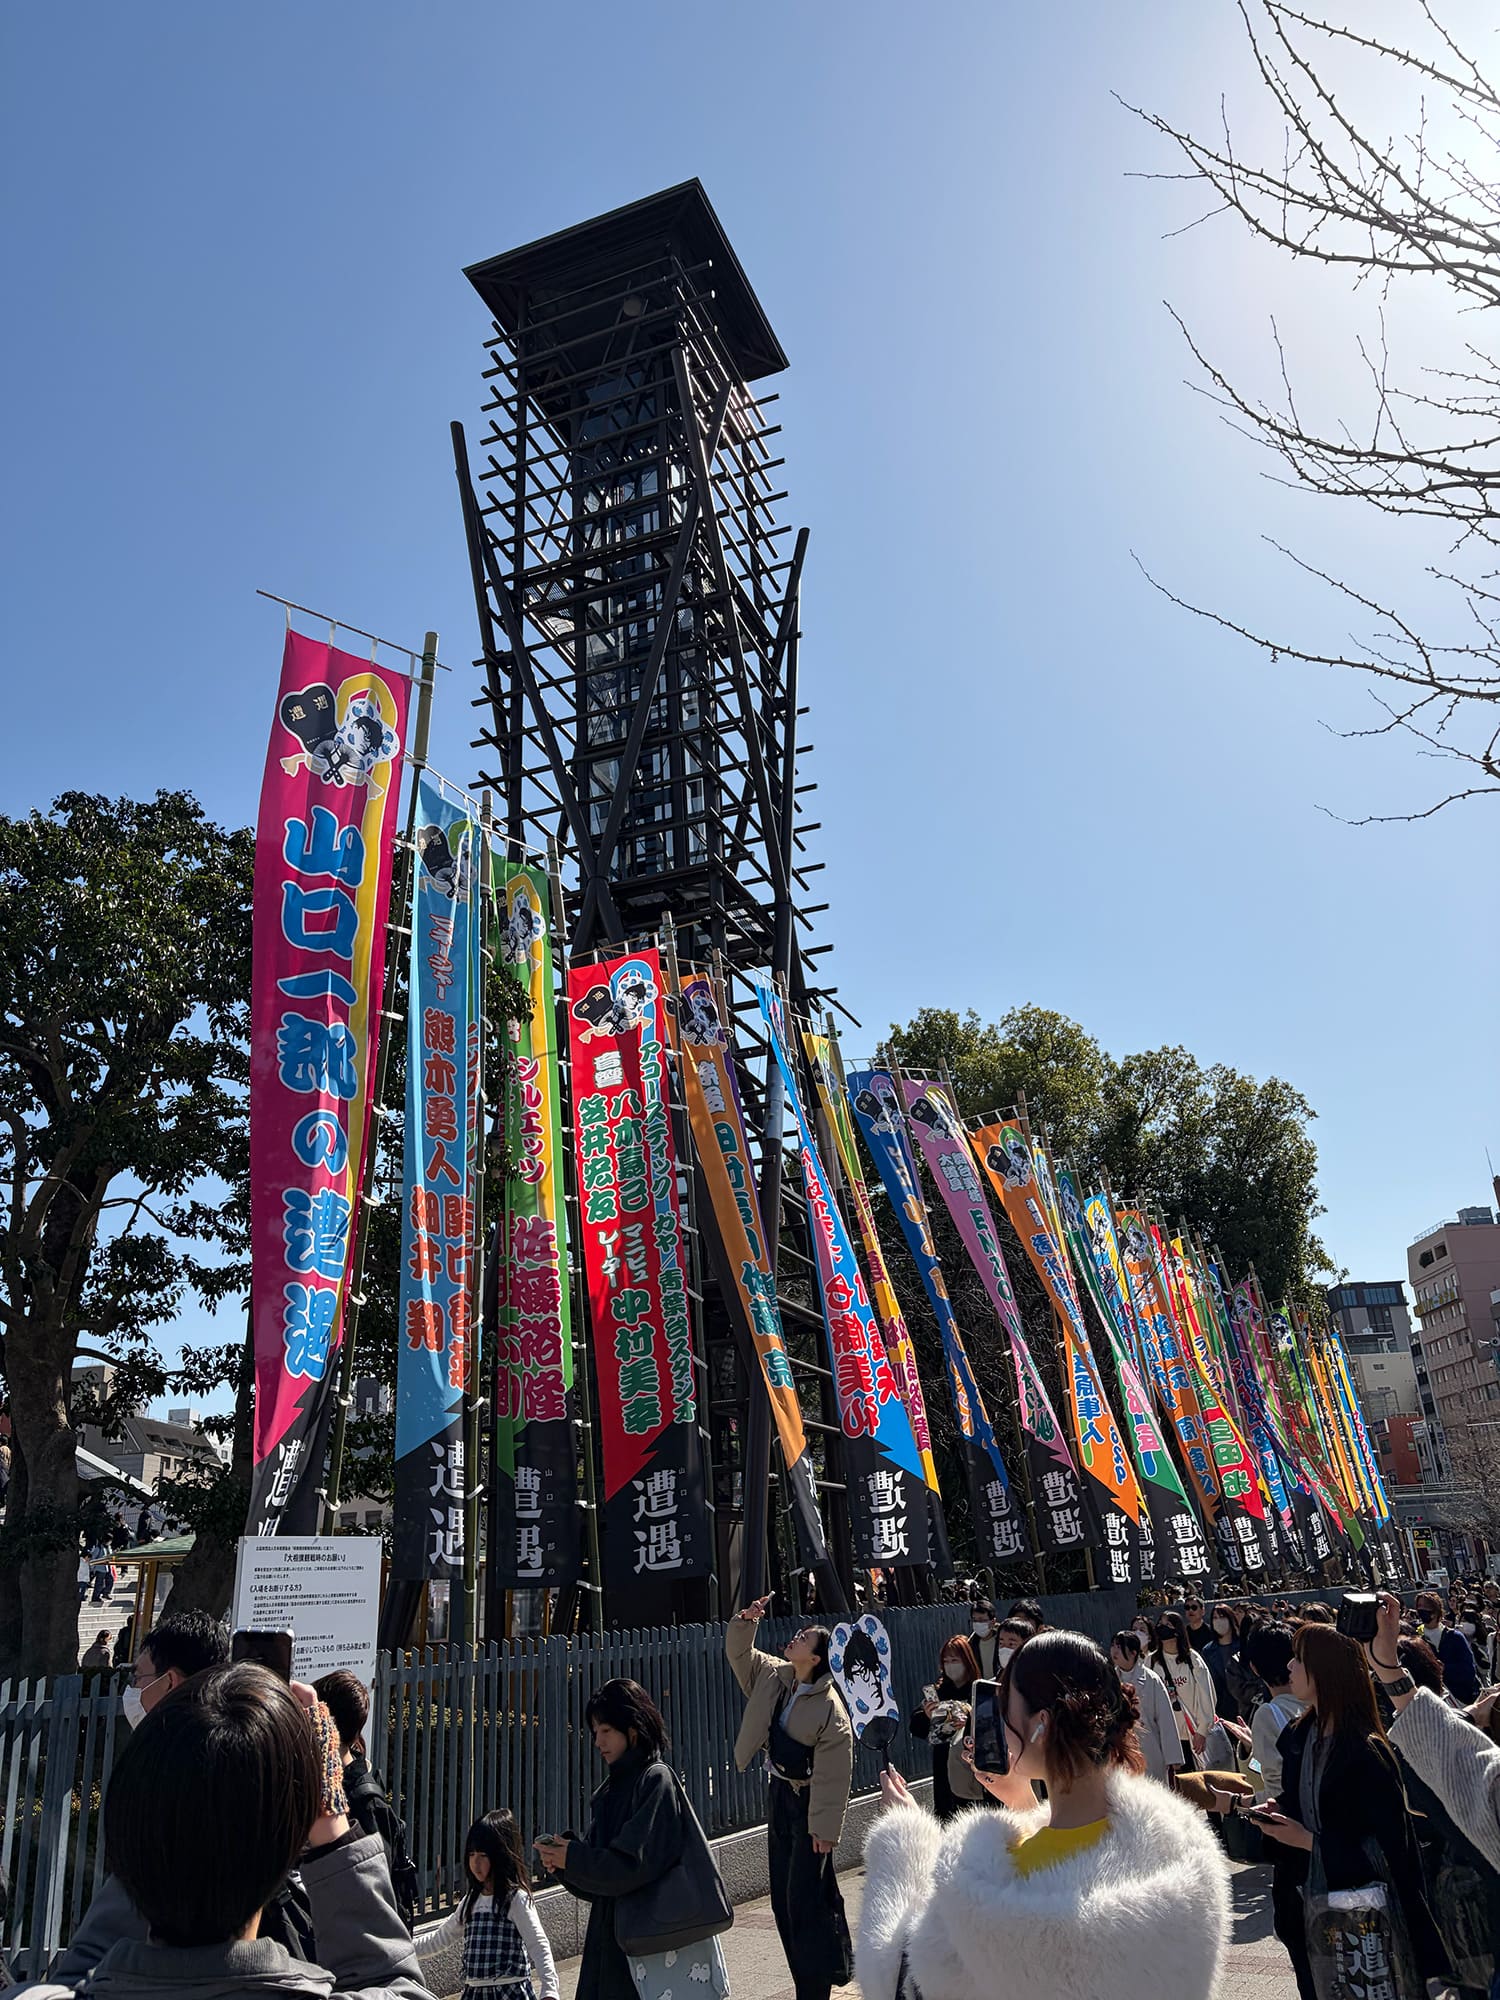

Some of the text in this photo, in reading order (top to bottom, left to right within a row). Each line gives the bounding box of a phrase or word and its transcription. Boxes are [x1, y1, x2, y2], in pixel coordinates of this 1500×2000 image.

[423, 1007, 462, 1187] 熊木勇人
[639, 1040, 675, 1201] アコースティック
[610, 1288, 663, 1435] 中村美幸
[631, 1469, 683, 1575] 遭遇
